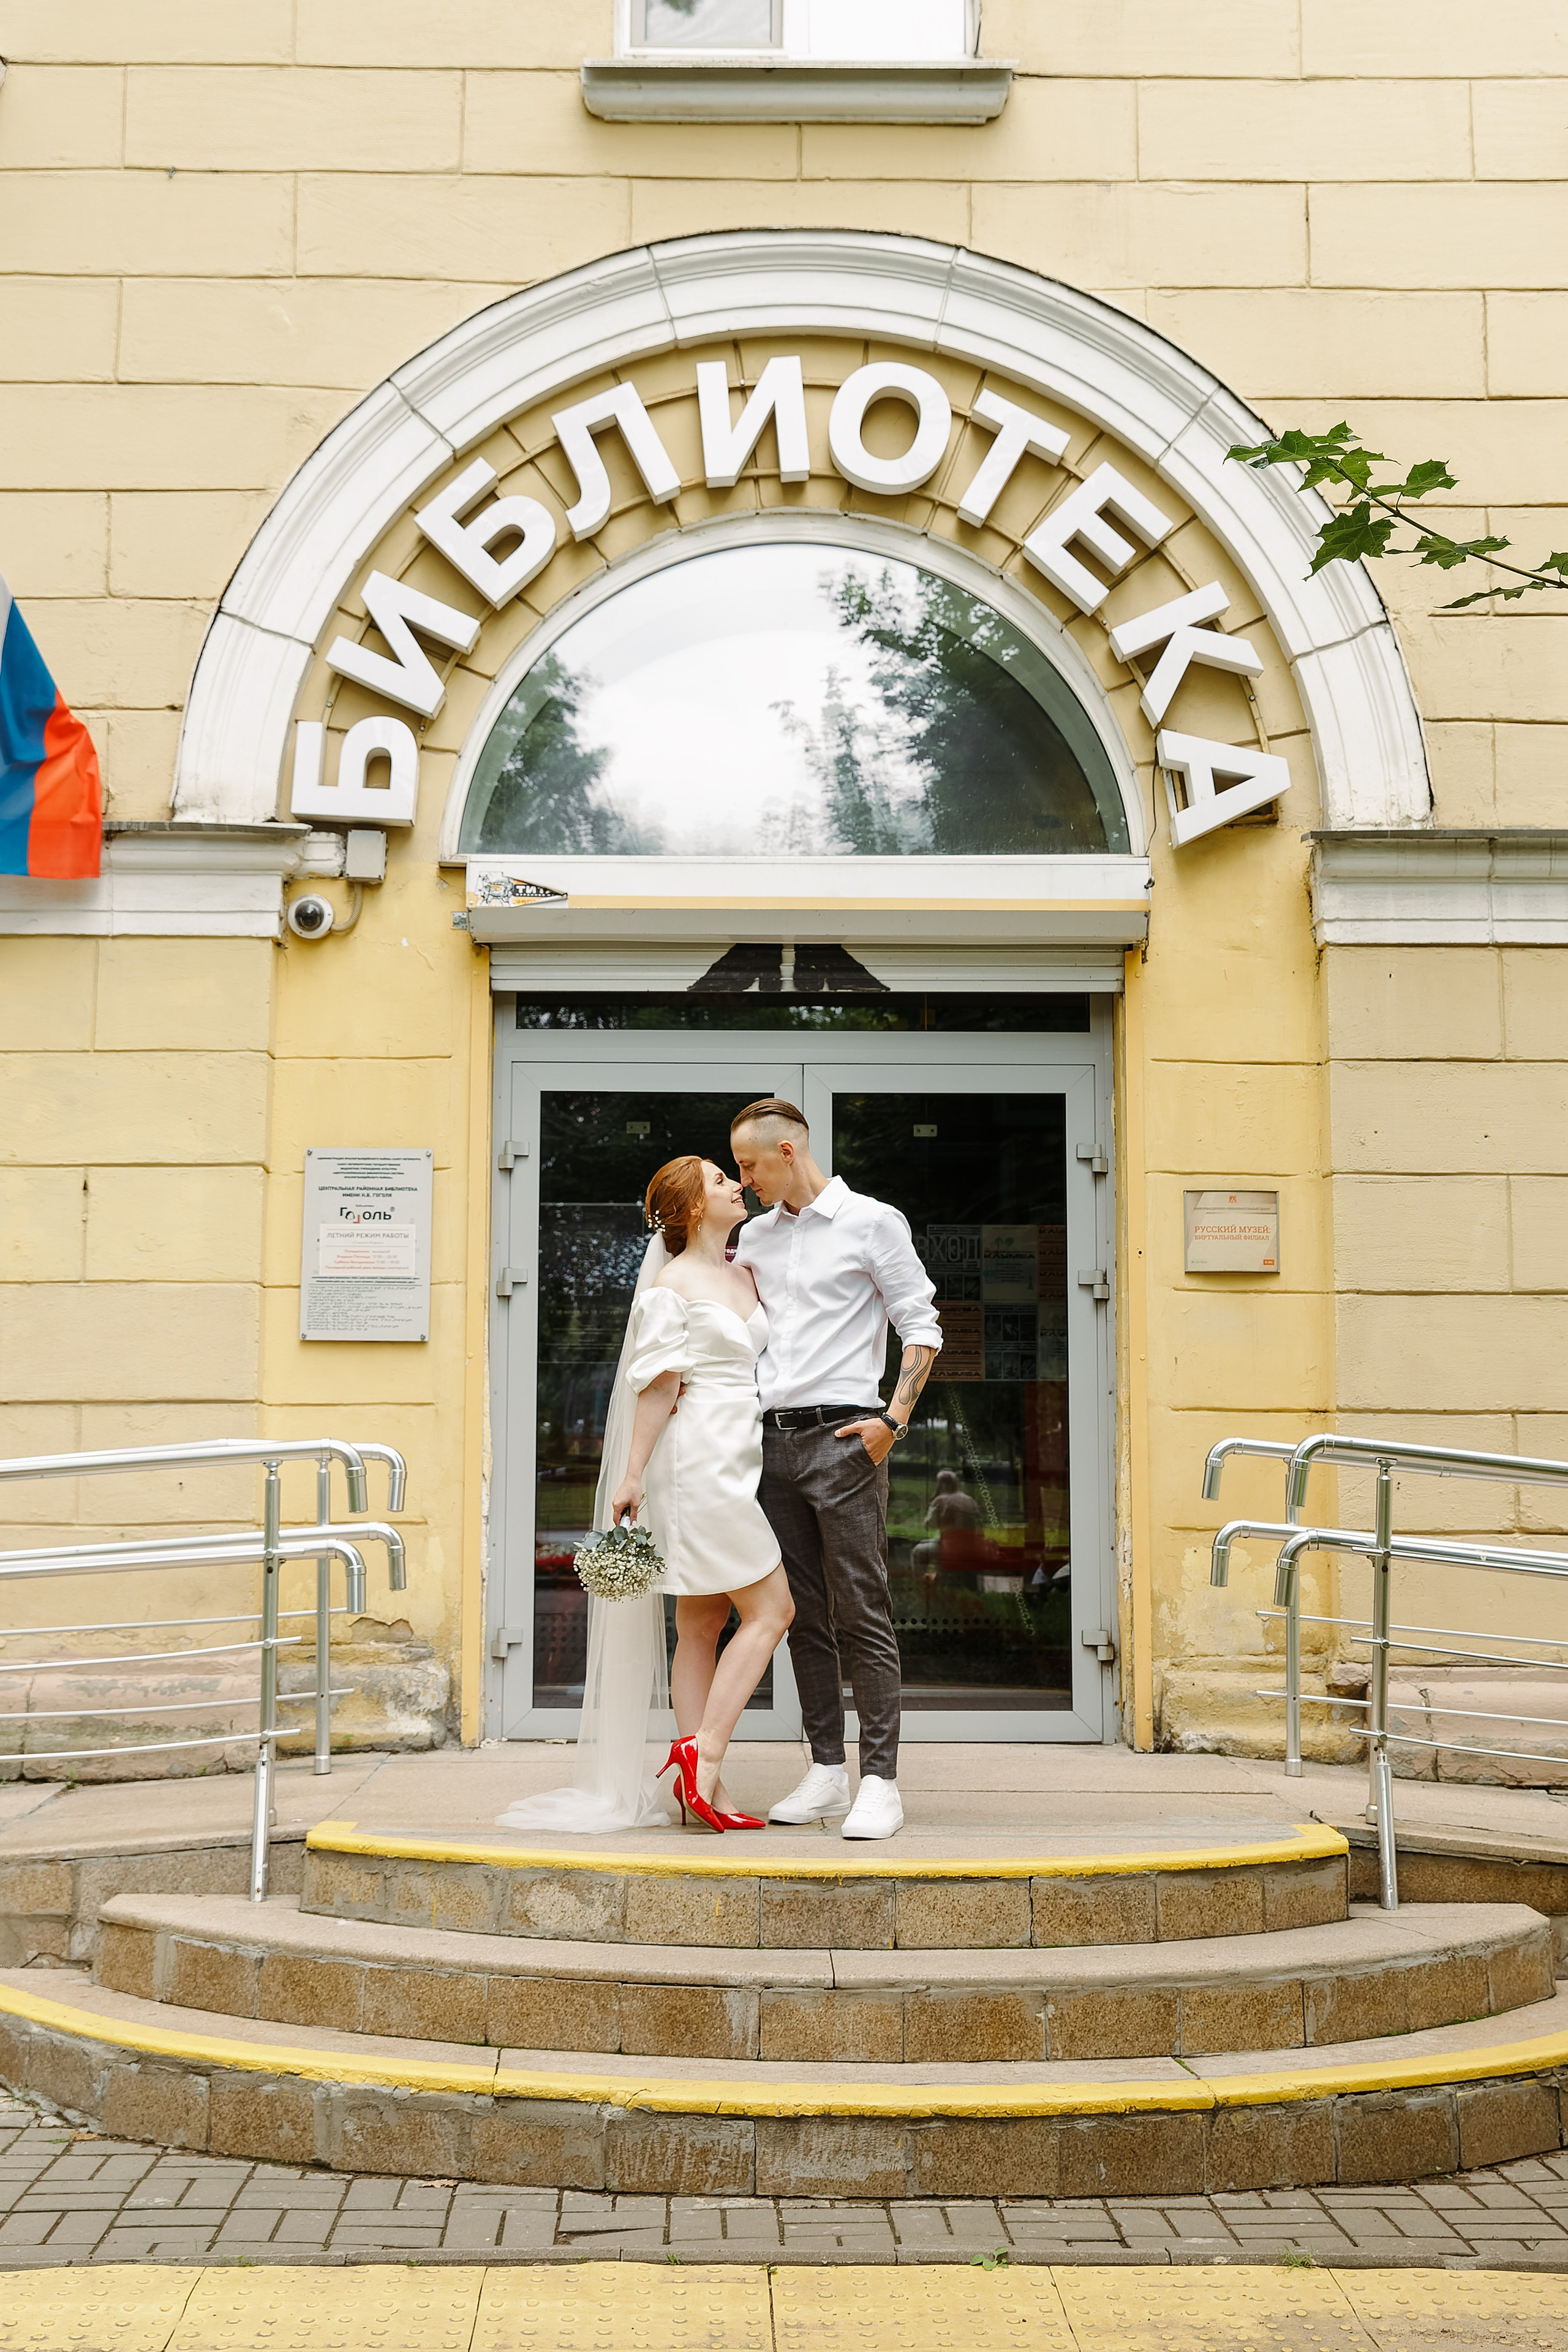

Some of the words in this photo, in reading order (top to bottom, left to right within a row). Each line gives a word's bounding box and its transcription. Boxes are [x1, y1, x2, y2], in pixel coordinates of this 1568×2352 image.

[291, 355, 1291, 849] БИБЛИОТЕКА
[1194, 1224, 1237, 1233] РУССКИЙ
[1238, 1225, 1270, 1234] МУЗЕЙ:
[914, 1235, 981, 1269] ВХОД
